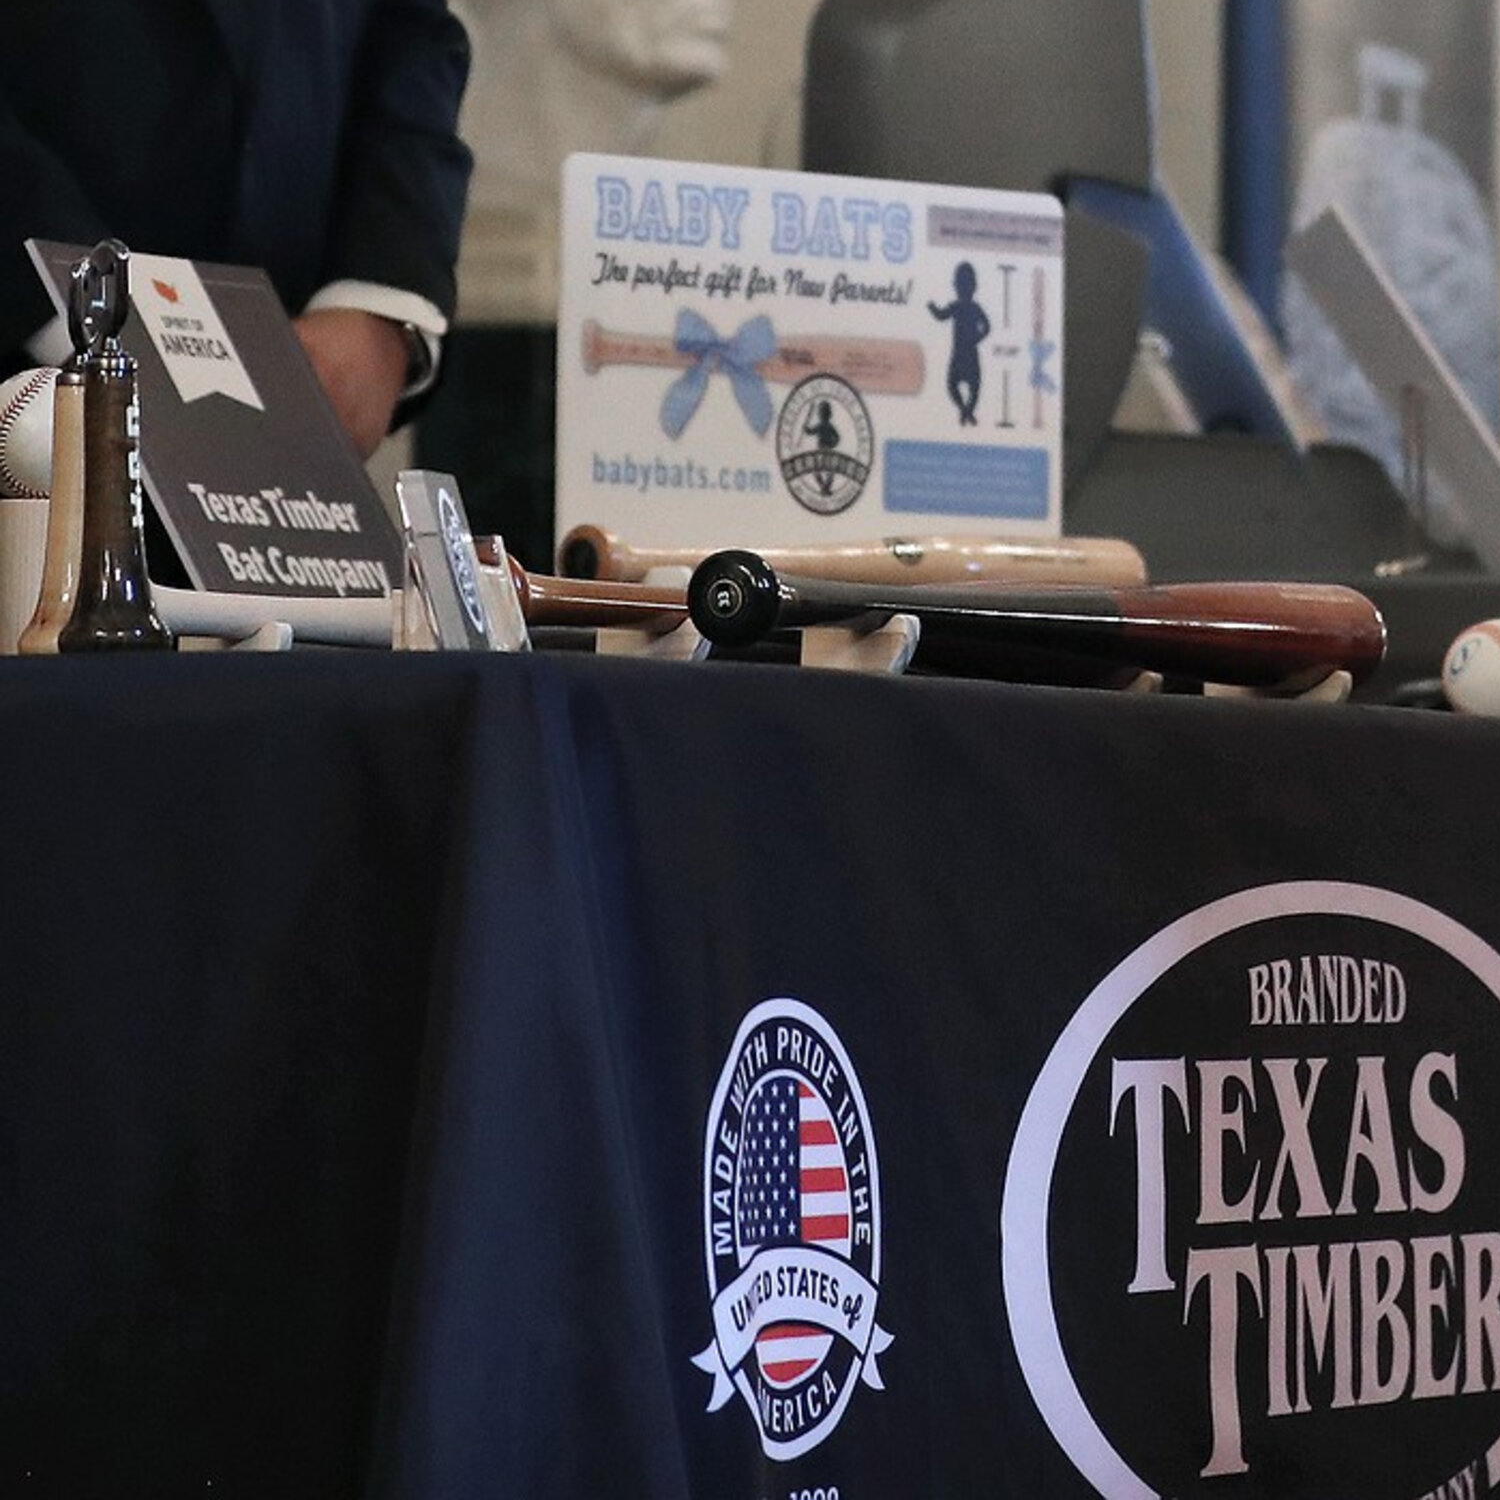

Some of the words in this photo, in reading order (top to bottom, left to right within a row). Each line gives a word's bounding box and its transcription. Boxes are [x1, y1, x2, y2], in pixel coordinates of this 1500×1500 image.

[595, 176, 749, 250] BABY
[771, 192, 914, 265] BATS
[592, 252, 627, 285] The
[631, 258, 700, 294] perfect
[704, 263, 741, 298] gift
[747, 267, 777, 296] for
[782, 269, 826, 299] New
[829, 273, 914, 305] Parents!
[160, 334, 232, 361] AMERICA
[592, 453, 771, 494] babybats.com
[186, 483, 272, 528] Texas
[260, 487, 360, 533] Timber
[217, 542, 276, 585] Bat
[267, 546, 391, 598] Company
[1248, 954, 1408, 1026] BRANDED
[713, 1120, 738, 1256] MADE
[730, 1031, 769, 1116] WITH
[776, 1026, 839, 1098] PRIDE
[836, 1093, 860, 1147] IN
[851, 1152, 872, 1246] THE
[1109, 1051, 1467, 1294] TEXAS
[730, 1270, 773, 1332] UNED
[776, 1266, 840, 1309] STATES
[843, 1293, 864, 1330] of
